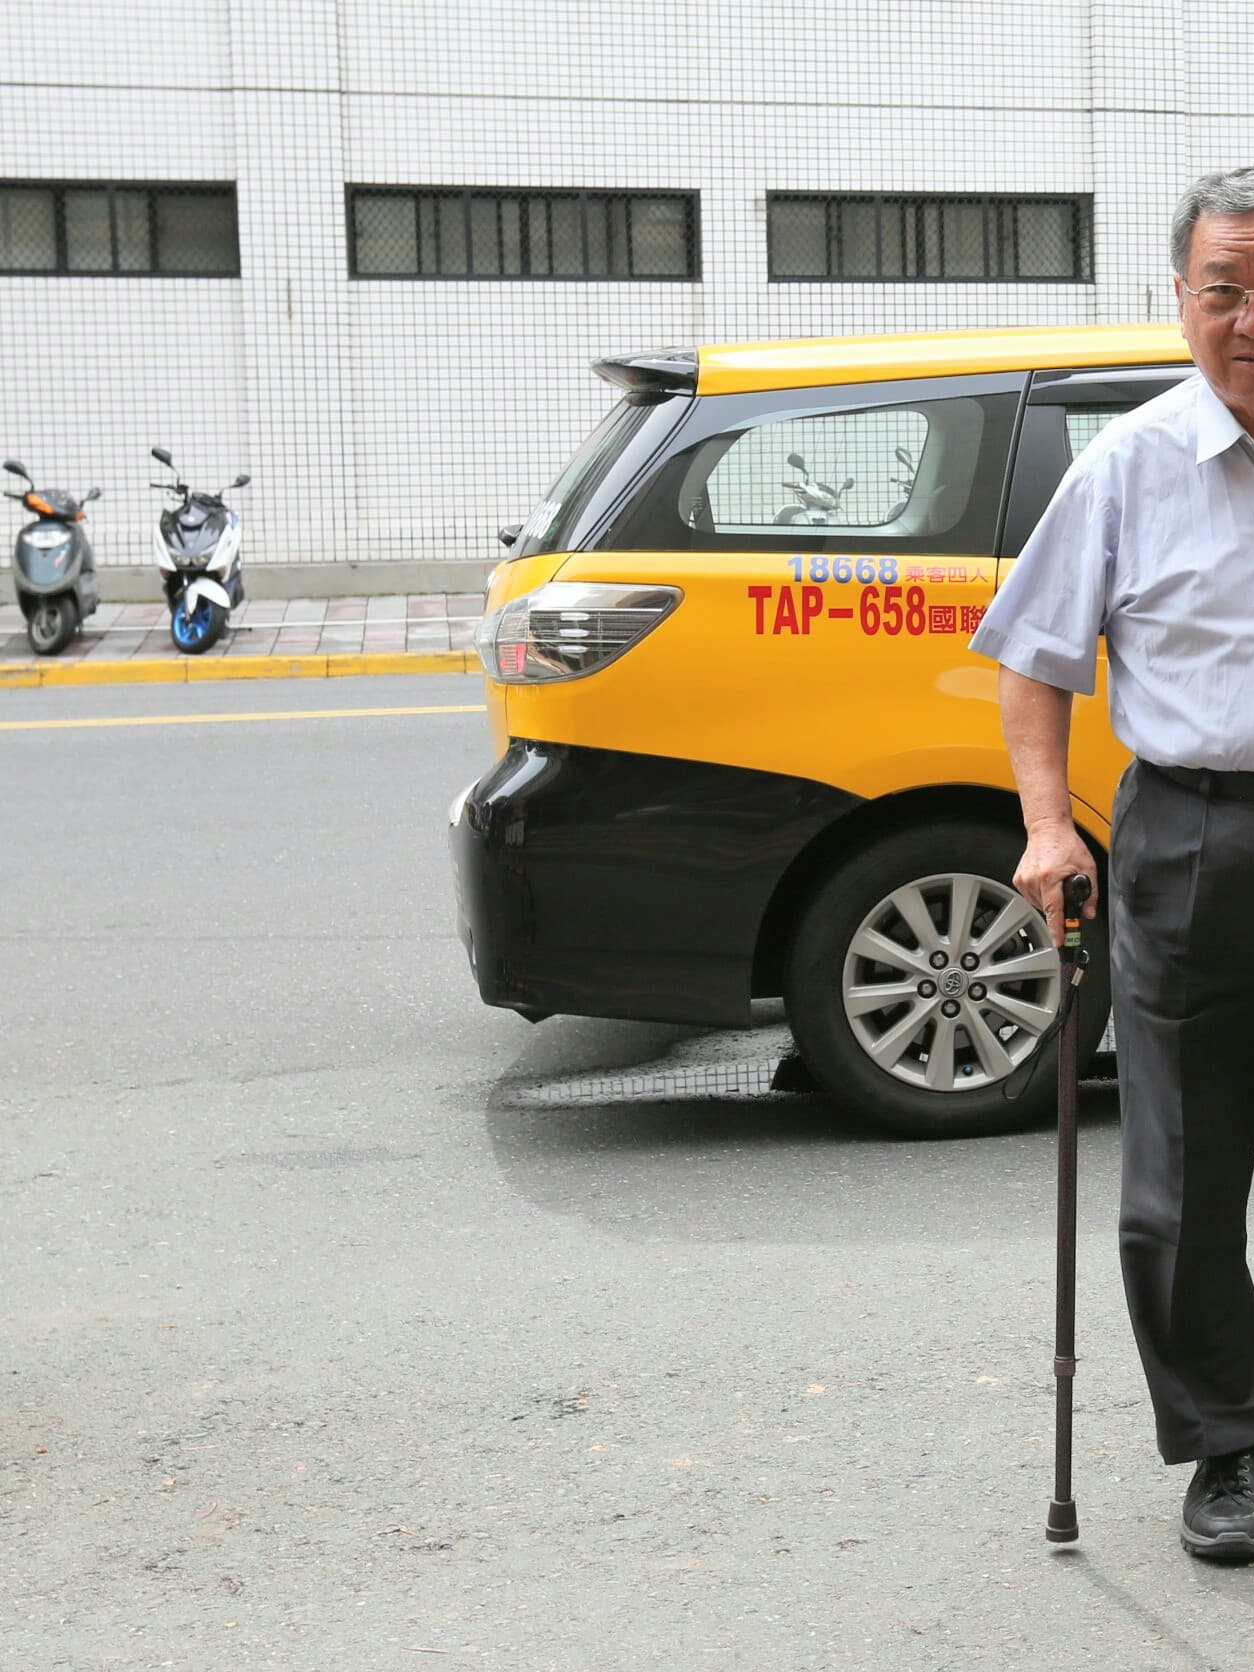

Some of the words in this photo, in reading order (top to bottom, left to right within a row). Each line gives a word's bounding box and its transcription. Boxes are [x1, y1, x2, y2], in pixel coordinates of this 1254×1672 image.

[787, 555, 898, 584] 18668
[905, 566, 989, 583] 乘客四人
[748, 586, 926, 636] TAP-658
